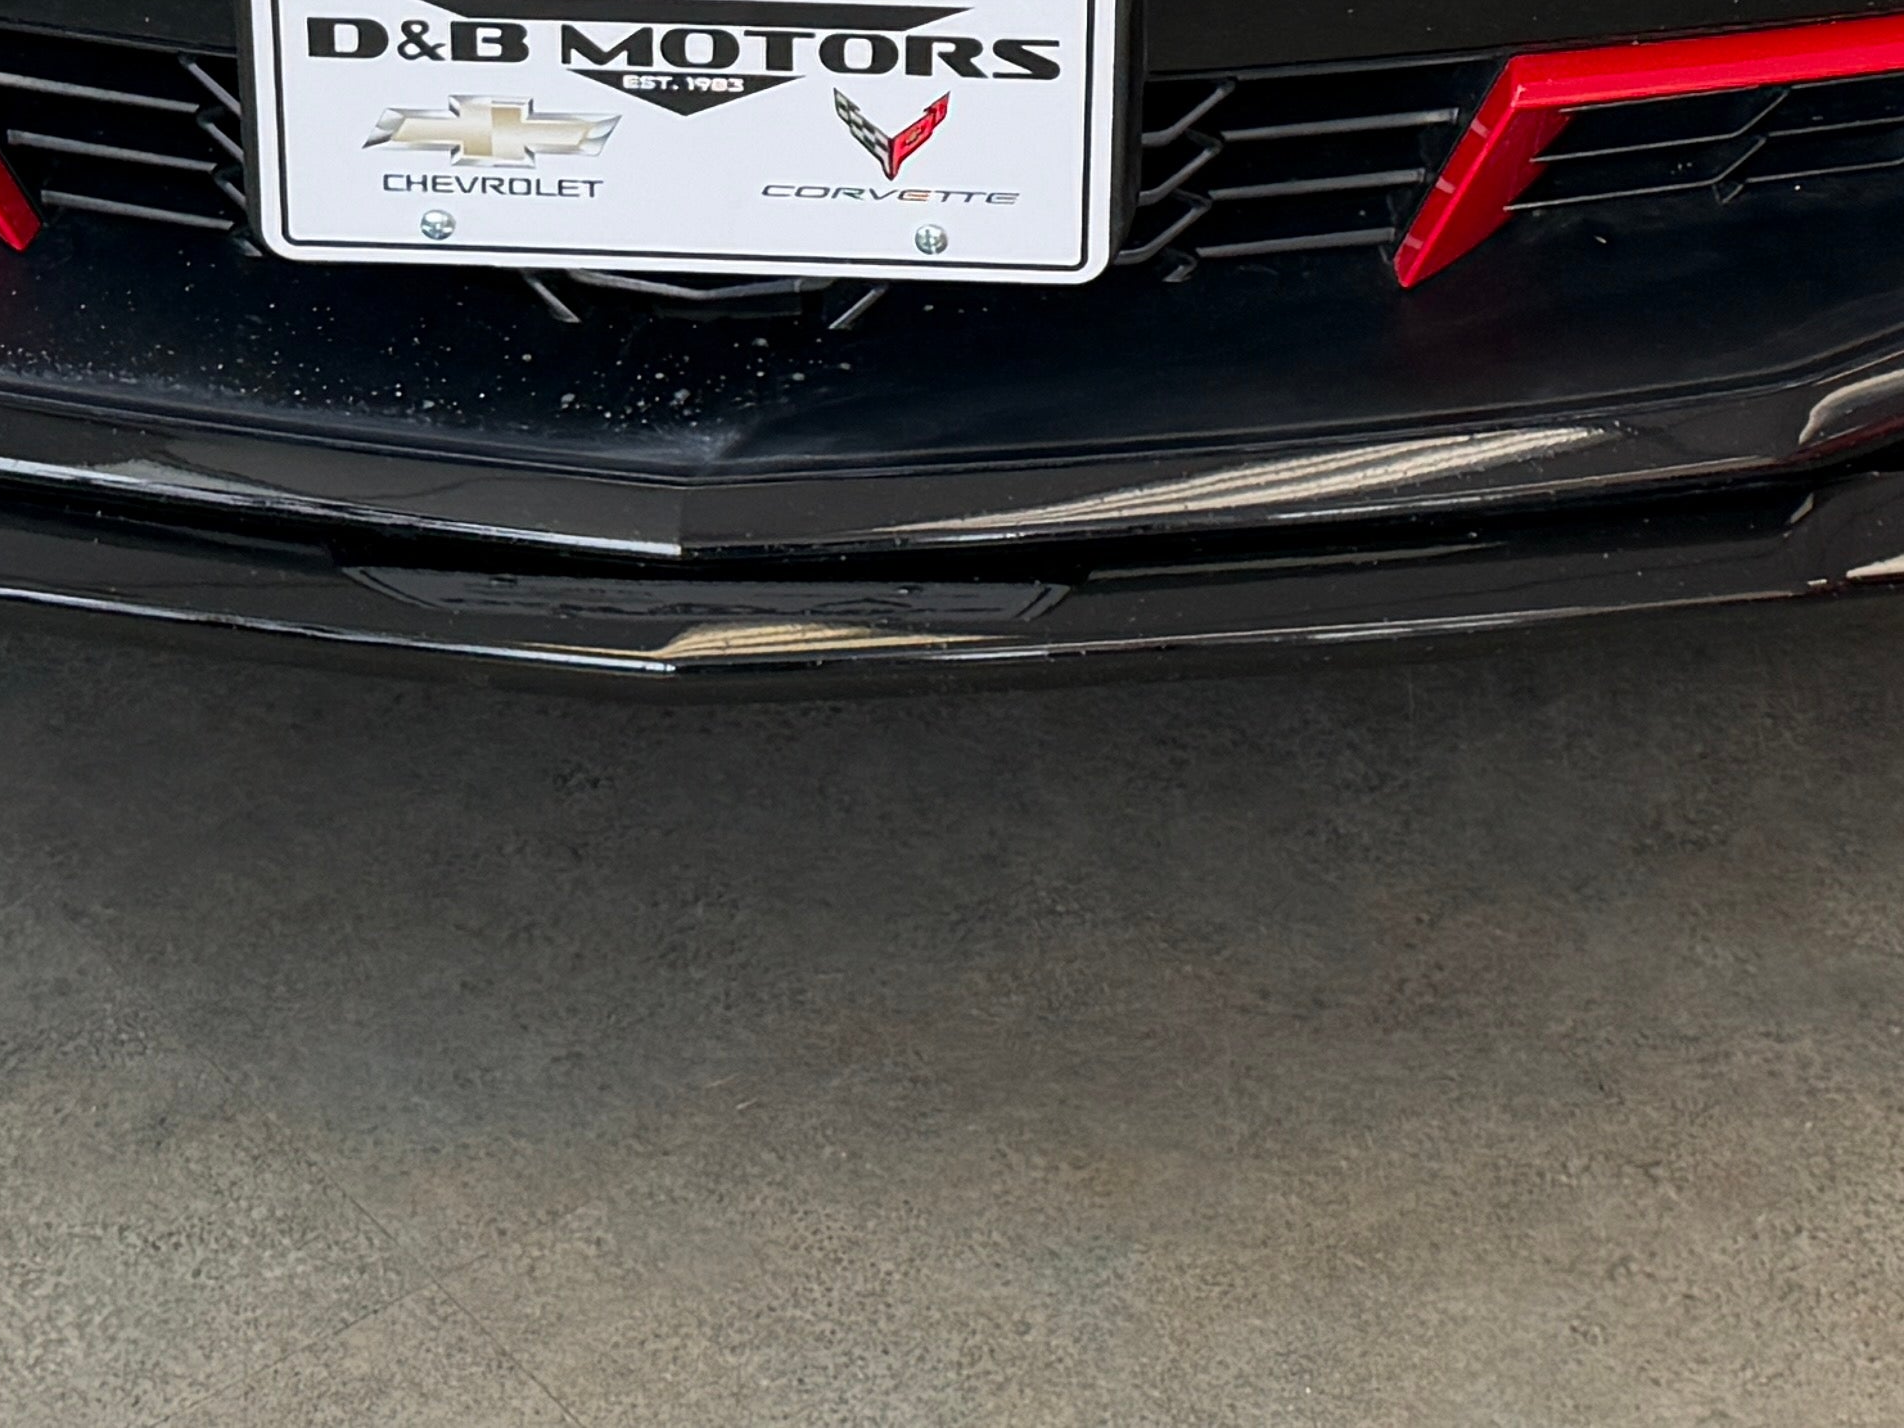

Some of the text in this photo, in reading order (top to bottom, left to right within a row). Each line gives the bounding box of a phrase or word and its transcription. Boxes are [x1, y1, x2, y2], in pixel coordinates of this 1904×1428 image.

[306, 16, 1061, 81] D&B MOTORS
[622, 74, 680, 91] EST.
[382, 172, 604, 198] CHEVROLET
[761, 184, 1020, 205] CORVETTE
